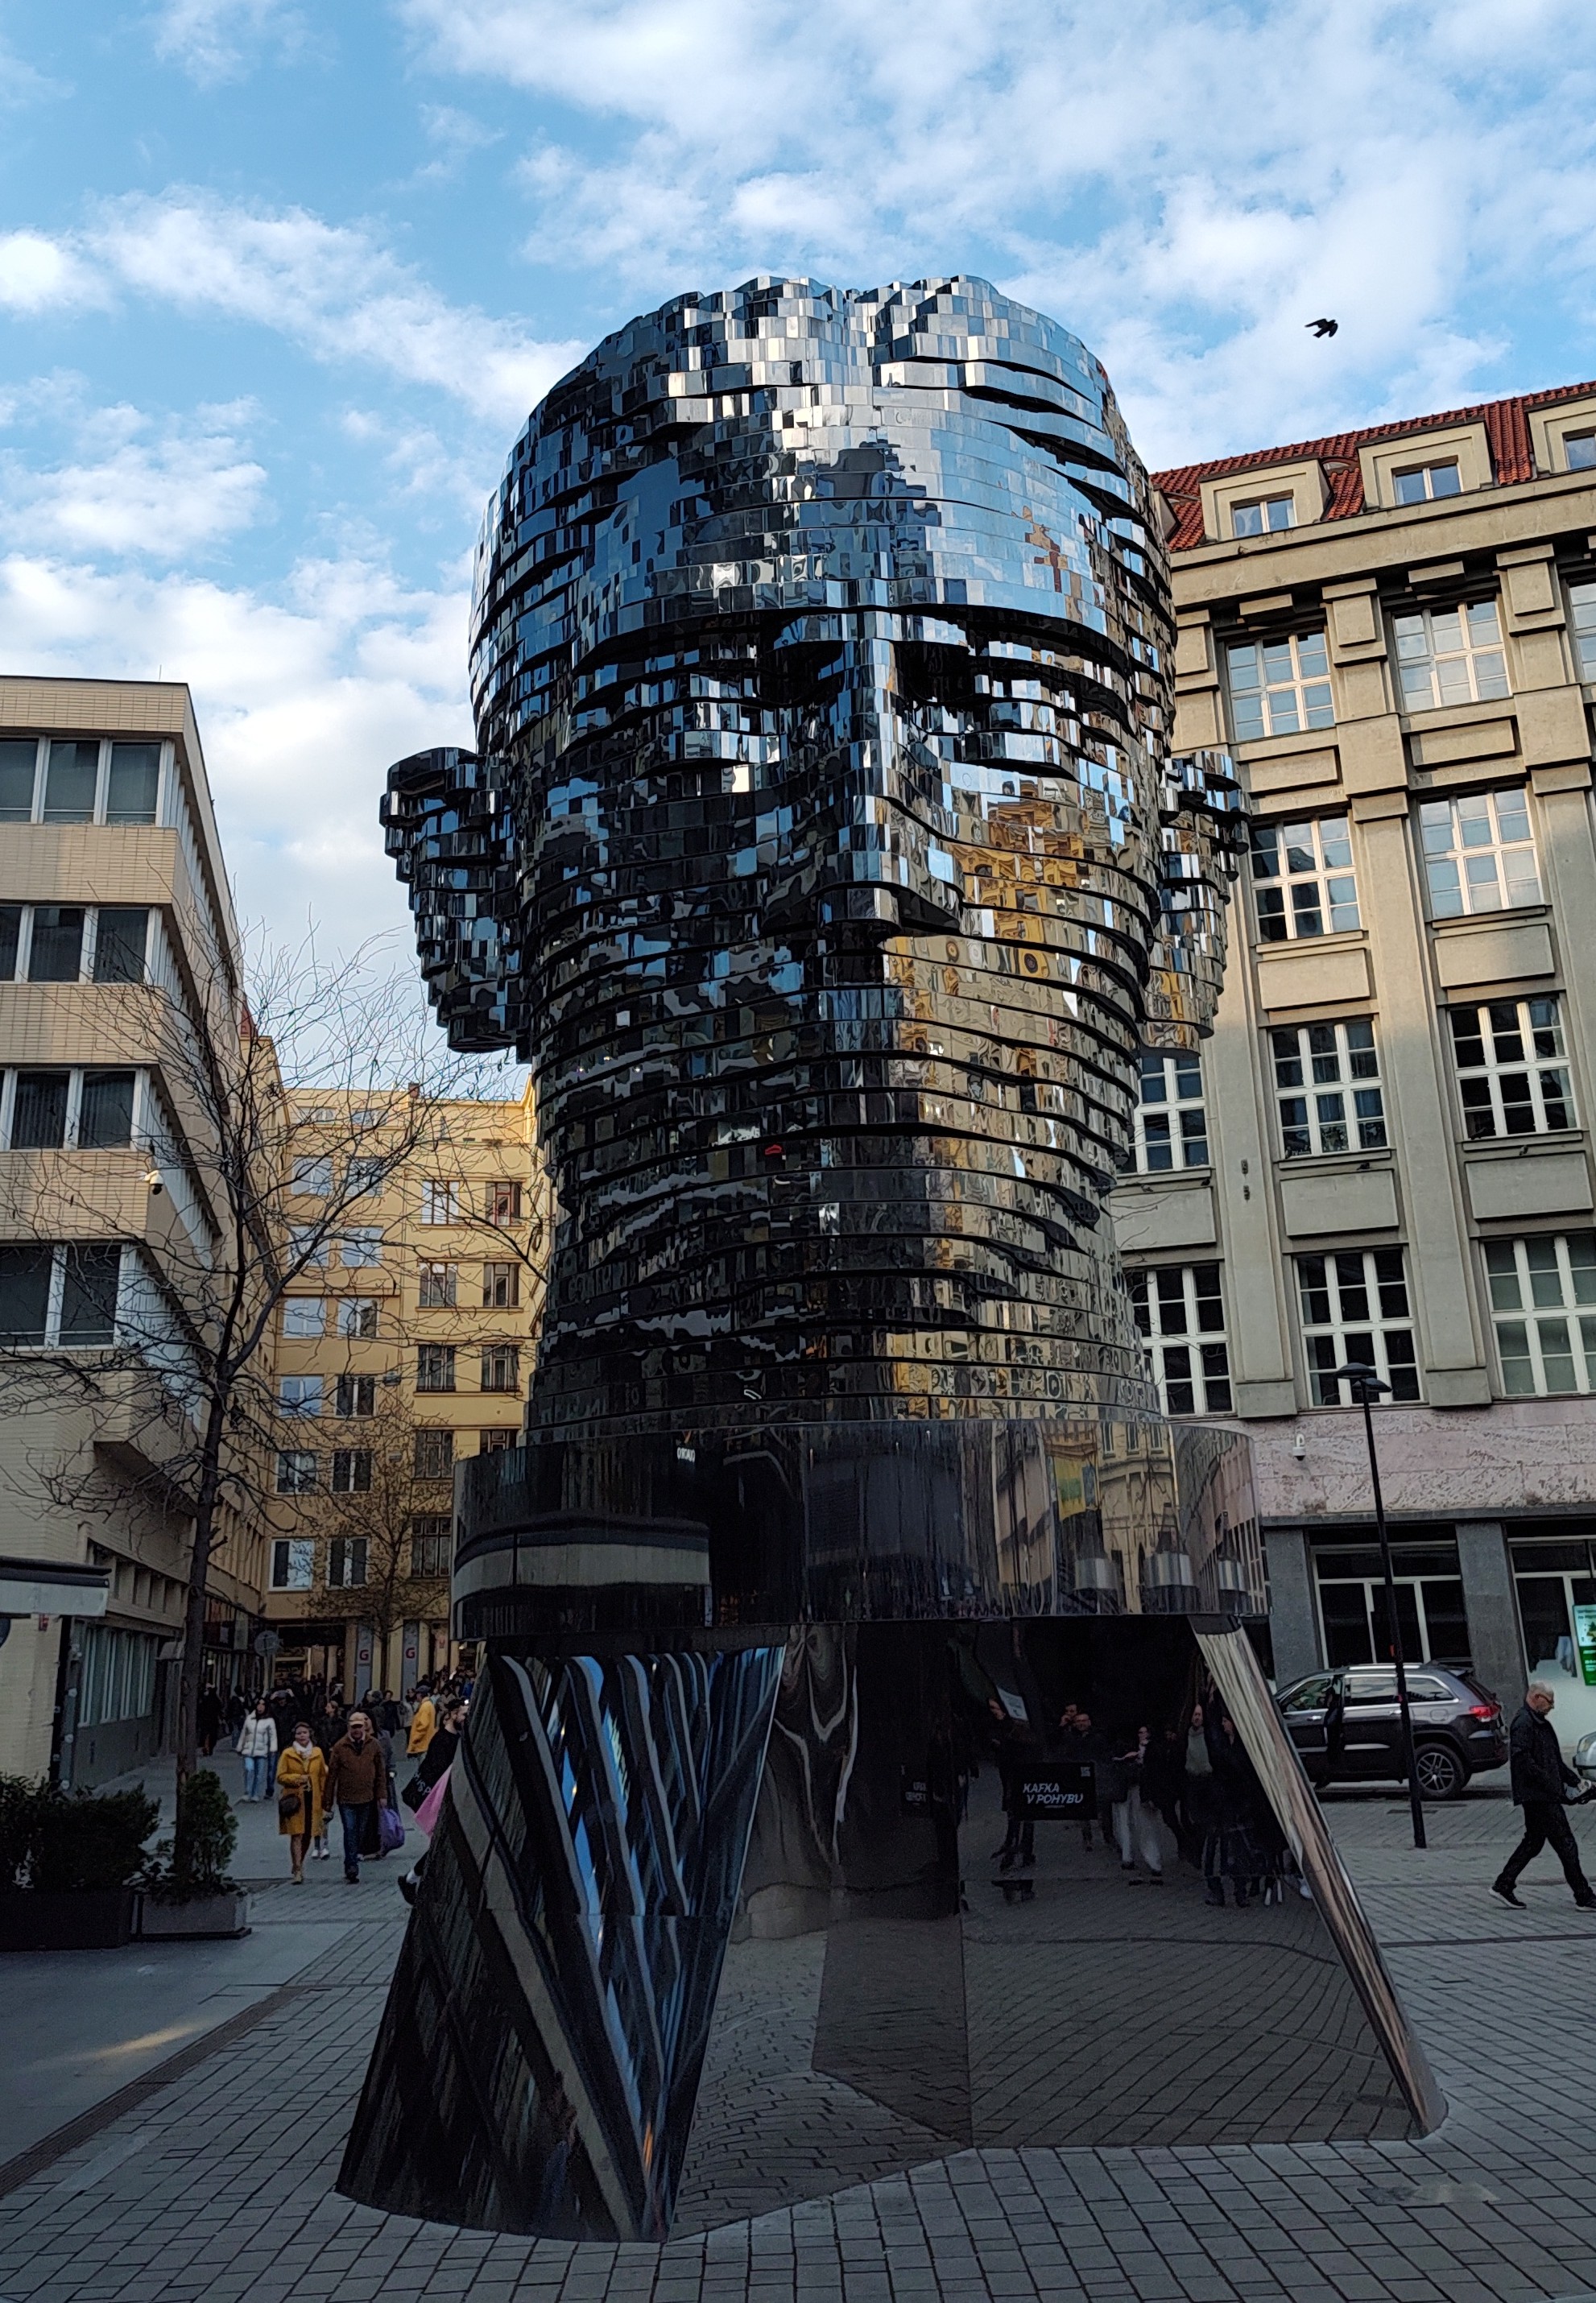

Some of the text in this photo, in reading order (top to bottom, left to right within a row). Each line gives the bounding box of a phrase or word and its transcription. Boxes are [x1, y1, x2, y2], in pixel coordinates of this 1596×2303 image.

[1023, 1782, 1060, 1793] KAFKA
[1027, 1792, 1084, 1804] V POHYBU
